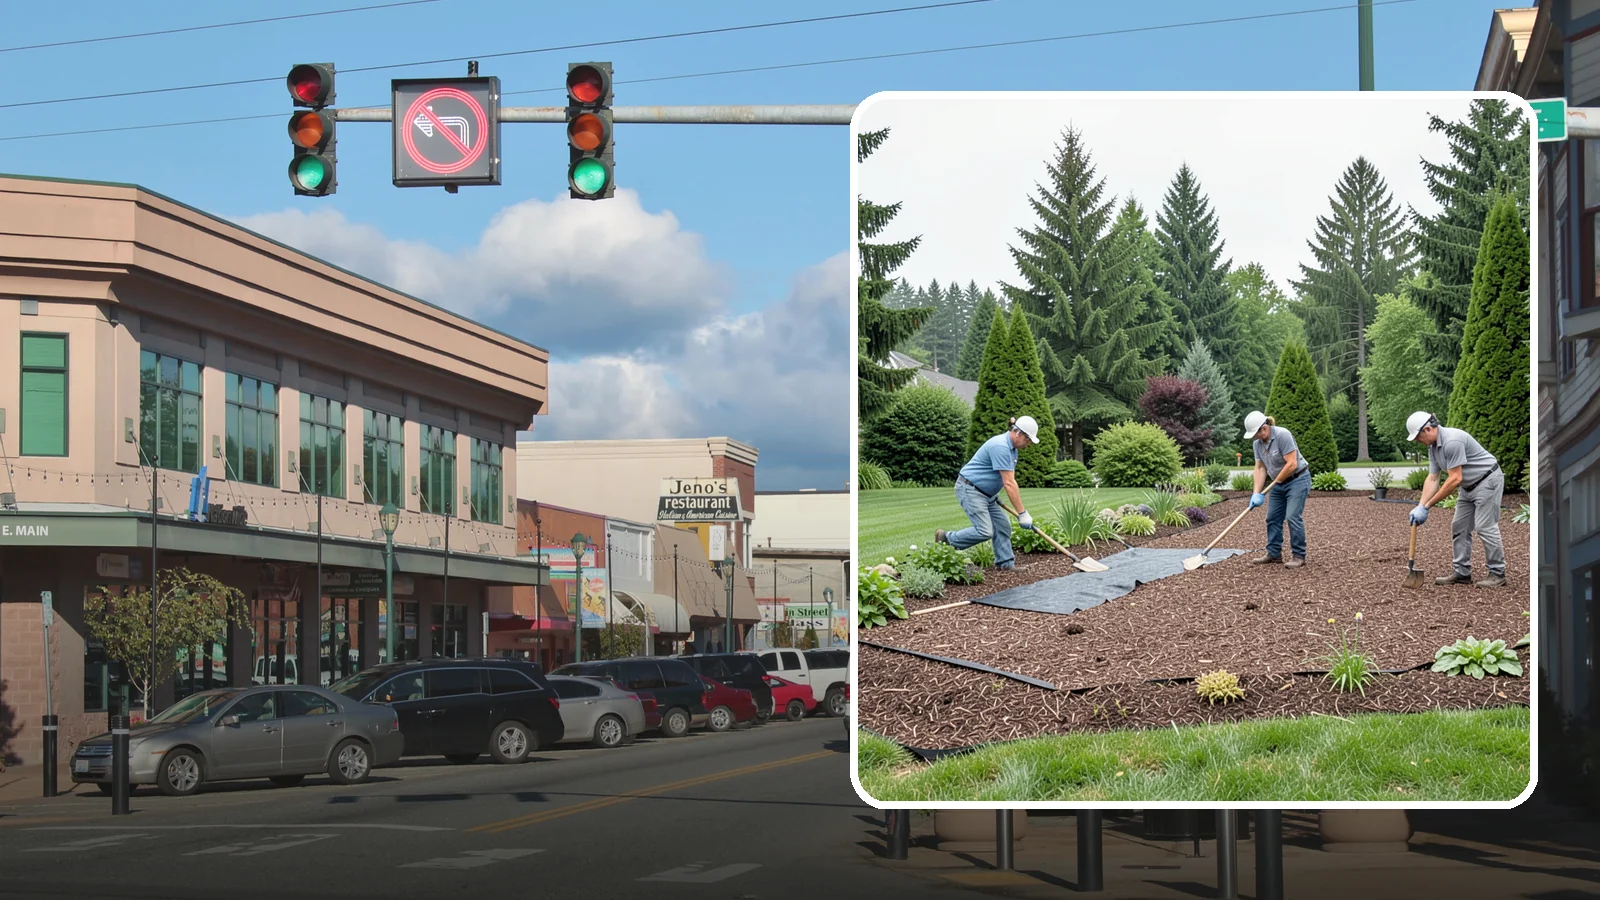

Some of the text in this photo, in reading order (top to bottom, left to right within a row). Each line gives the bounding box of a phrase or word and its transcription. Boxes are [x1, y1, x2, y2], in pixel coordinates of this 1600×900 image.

[670, 480, 727, 494] Jeno's
[665, 496, 731, 509] restaurant
[686, 509, 715, 519] American
[715, 509, 738, 519] Cuisine
[2, 525, 49, 536] E. MAIN
[797, 608, 828, 616] Street
